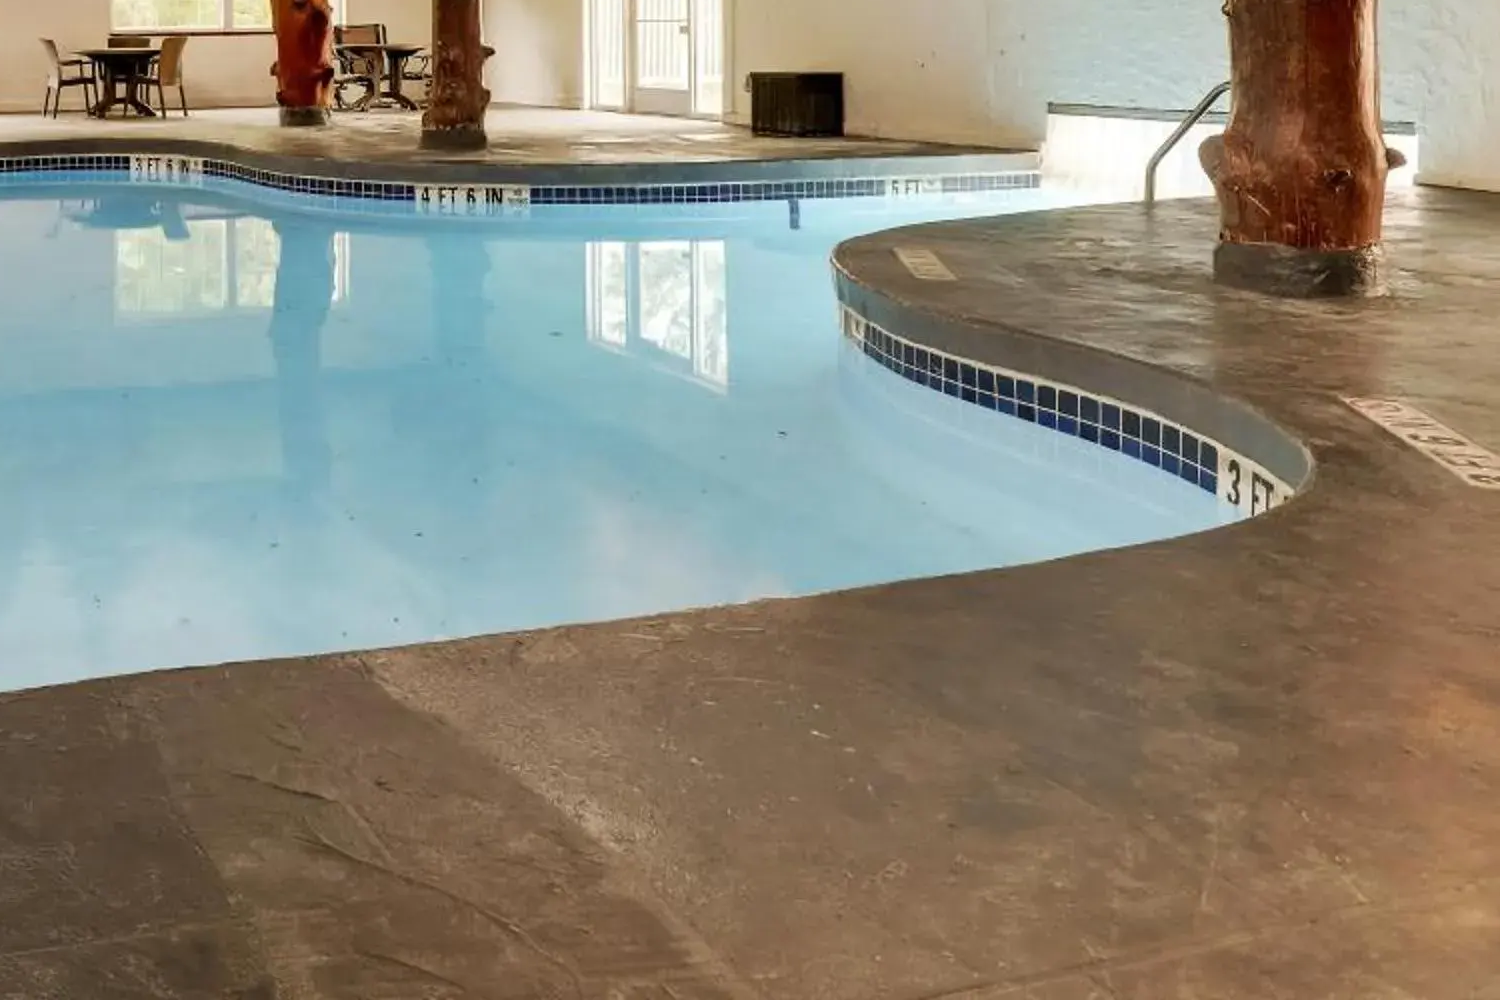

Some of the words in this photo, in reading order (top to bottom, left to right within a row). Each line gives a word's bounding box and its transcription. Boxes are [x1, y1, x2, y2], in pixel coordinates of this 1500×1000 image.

[147, 157, 161, 172] FT
[421, 186, 430, 202] 4
[438, 186, 458, 203] FT
[485, 187, 504, 203] IN
[905, 179, 920, 195] FT
[1227, 459, 1241, 505] 3
[1251, 471, 1275, 517] FT
